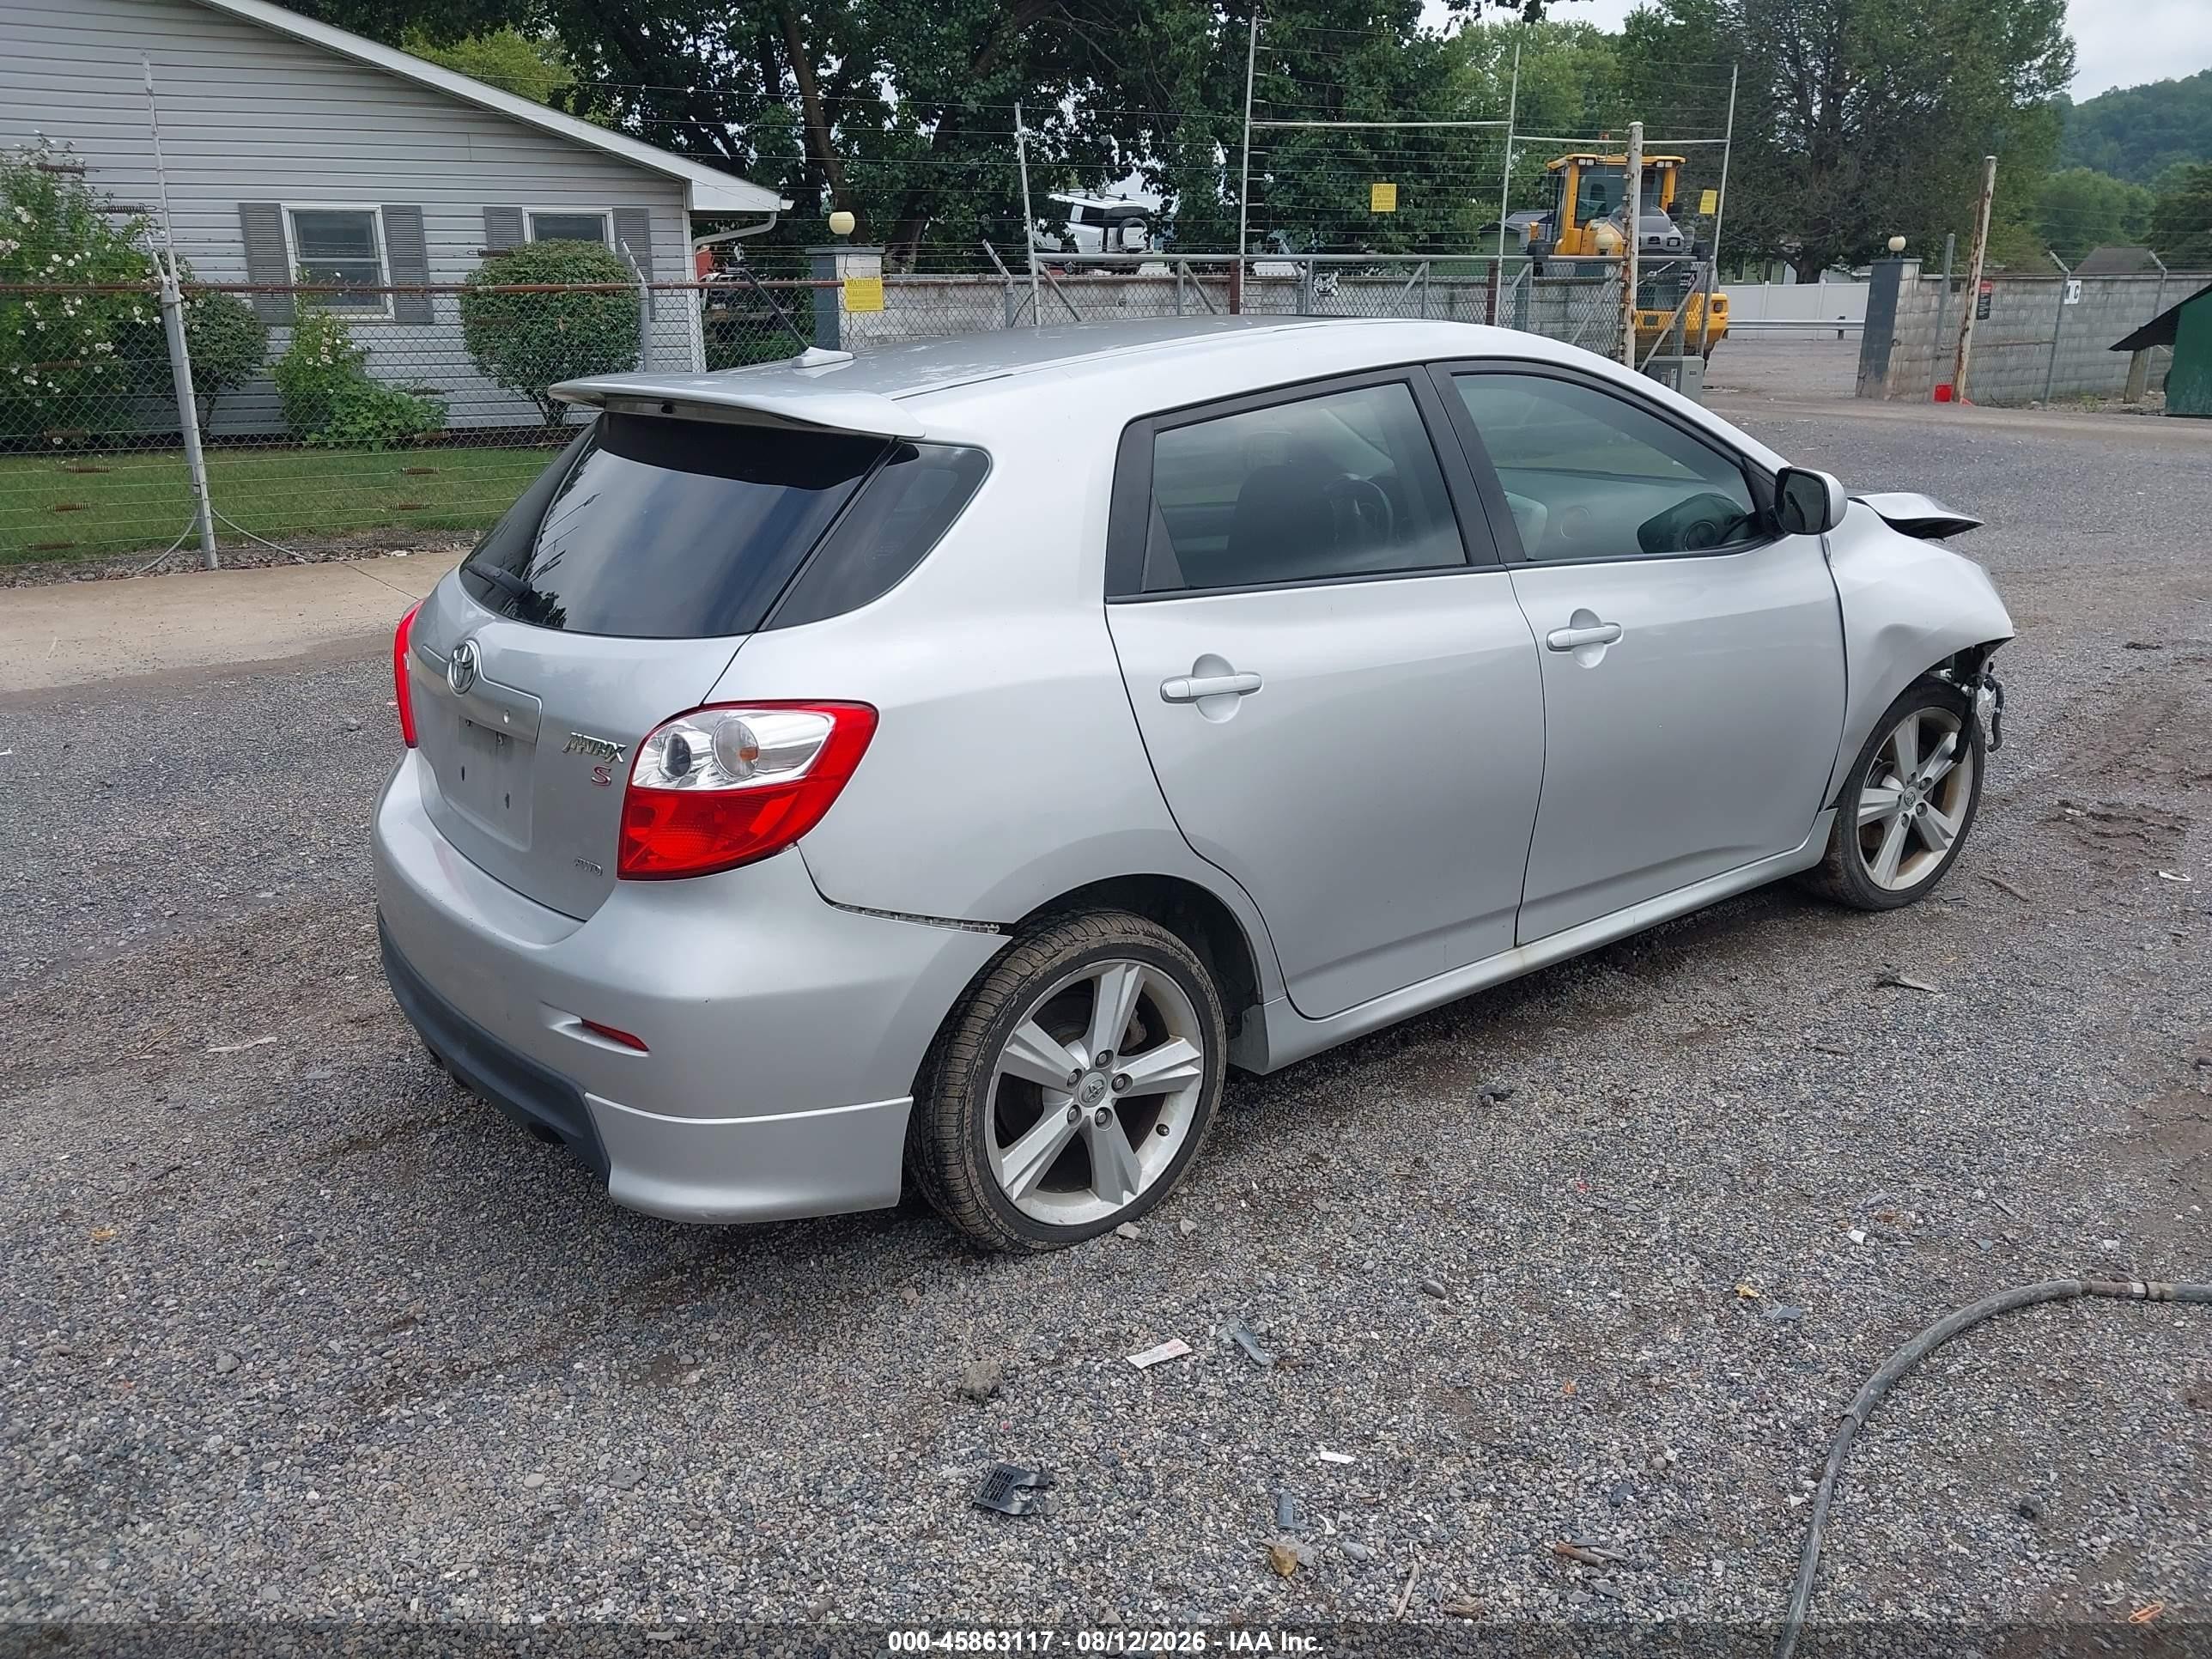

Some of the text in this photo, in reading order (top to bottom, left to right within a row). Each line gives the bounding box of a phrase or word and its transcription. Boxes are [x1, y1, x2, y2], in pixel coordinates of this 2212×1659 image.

[846, 279, 879, 288] WARNING
[562, 732, 628, 763] MATRIX
[592, 765, 612, 786] S
